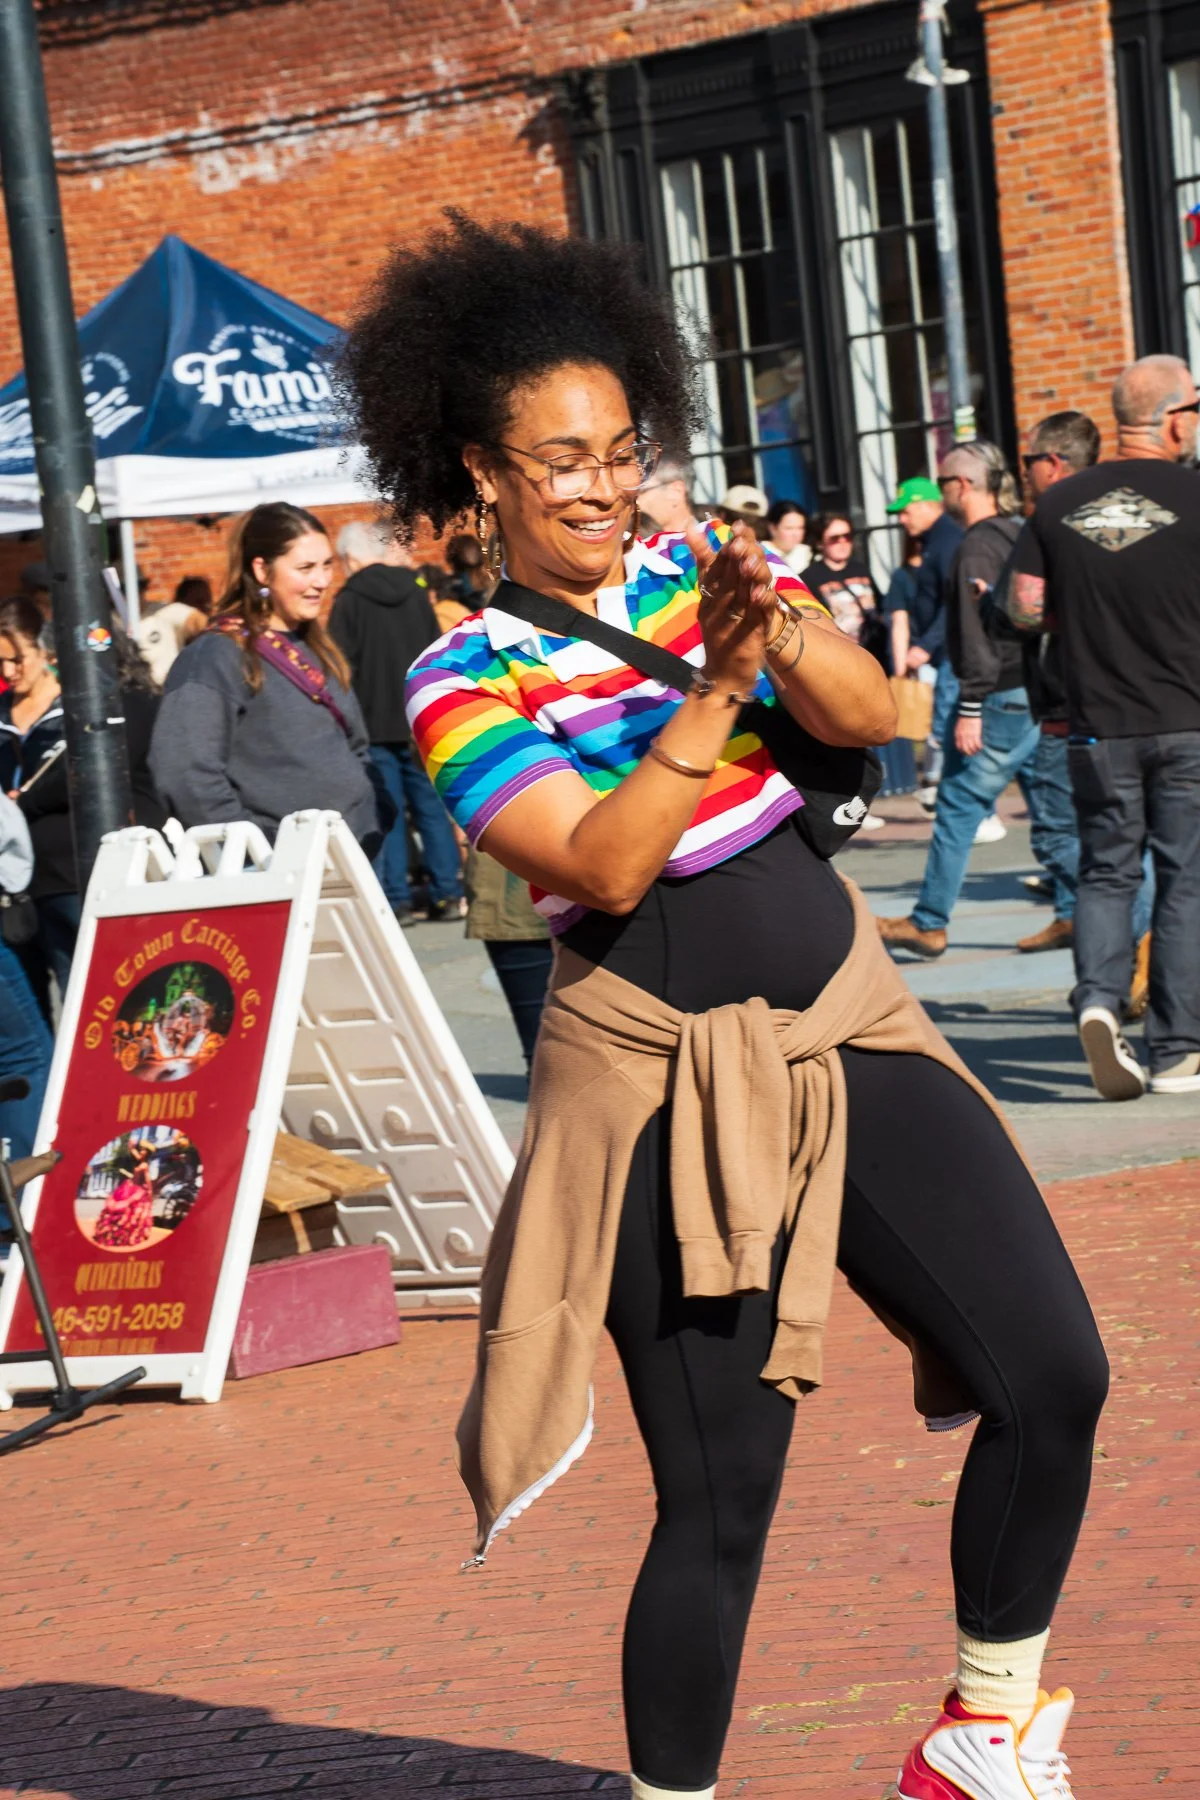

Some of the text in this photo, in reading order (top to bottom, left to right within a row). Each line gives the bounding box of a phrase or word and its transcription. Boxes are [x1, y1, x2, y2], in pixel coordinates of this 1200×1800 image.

[172, 347, 331, 408] Fami
[114, 930, 175, 988] Town
[180, 917, 252, 985] Carriage
[240, 988, 262, 1040] Co.
[117, 1091, 198, 1122] WEDDINGS
